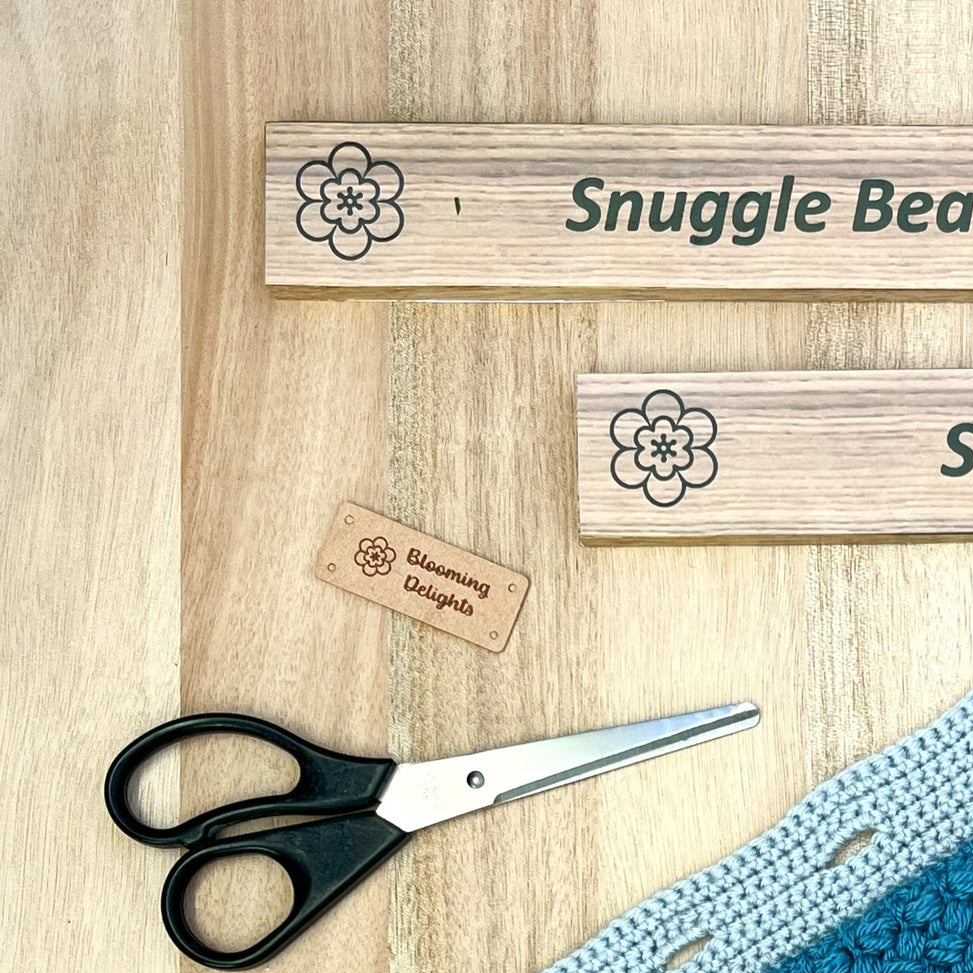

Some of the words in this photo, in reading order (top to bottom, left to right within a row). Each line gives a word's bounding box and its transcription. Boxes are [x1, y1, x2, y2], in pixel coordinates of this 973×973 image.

[564, 174, 831, 246] Snuggle
[403, 574, 474, 617] Delights
[406, 547, 491, 599] Blooming
